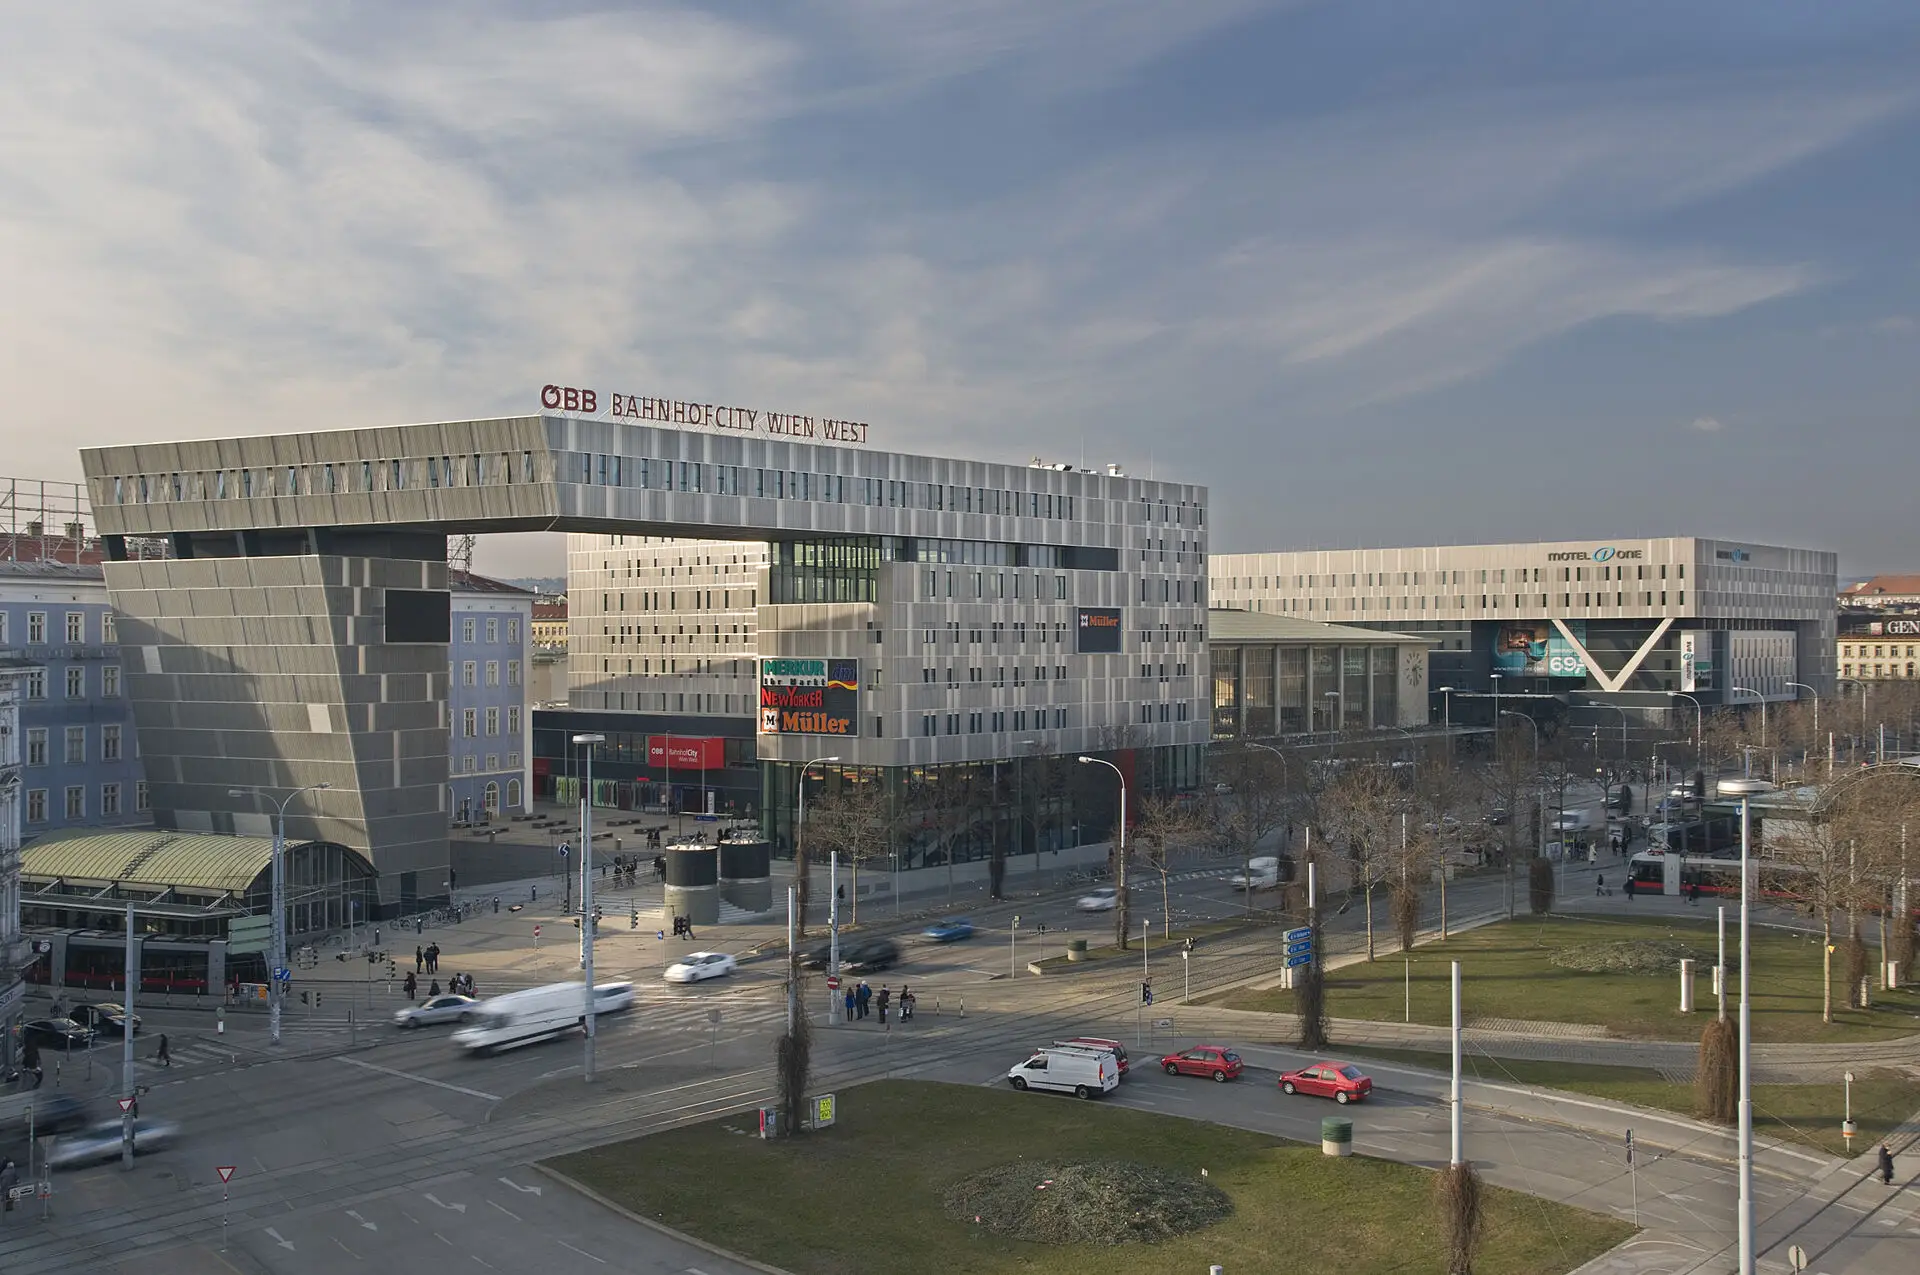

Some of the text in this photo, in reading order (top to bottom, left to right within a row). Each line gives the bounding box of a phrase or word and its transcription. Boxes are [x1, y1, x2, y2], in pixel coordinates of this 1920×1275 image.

[541, 384, 869, 443] ÖBB BAHNHOFCITY WIEN WEST
[1548, 551, 1591, 562] MOTEL
[1089, 615, 1119, 627] Müller
[764, 660, 825, 676] MERKUR
[764, 678, 826, 686] Ihr Markt
[782, 711, 850, 733] Müller
